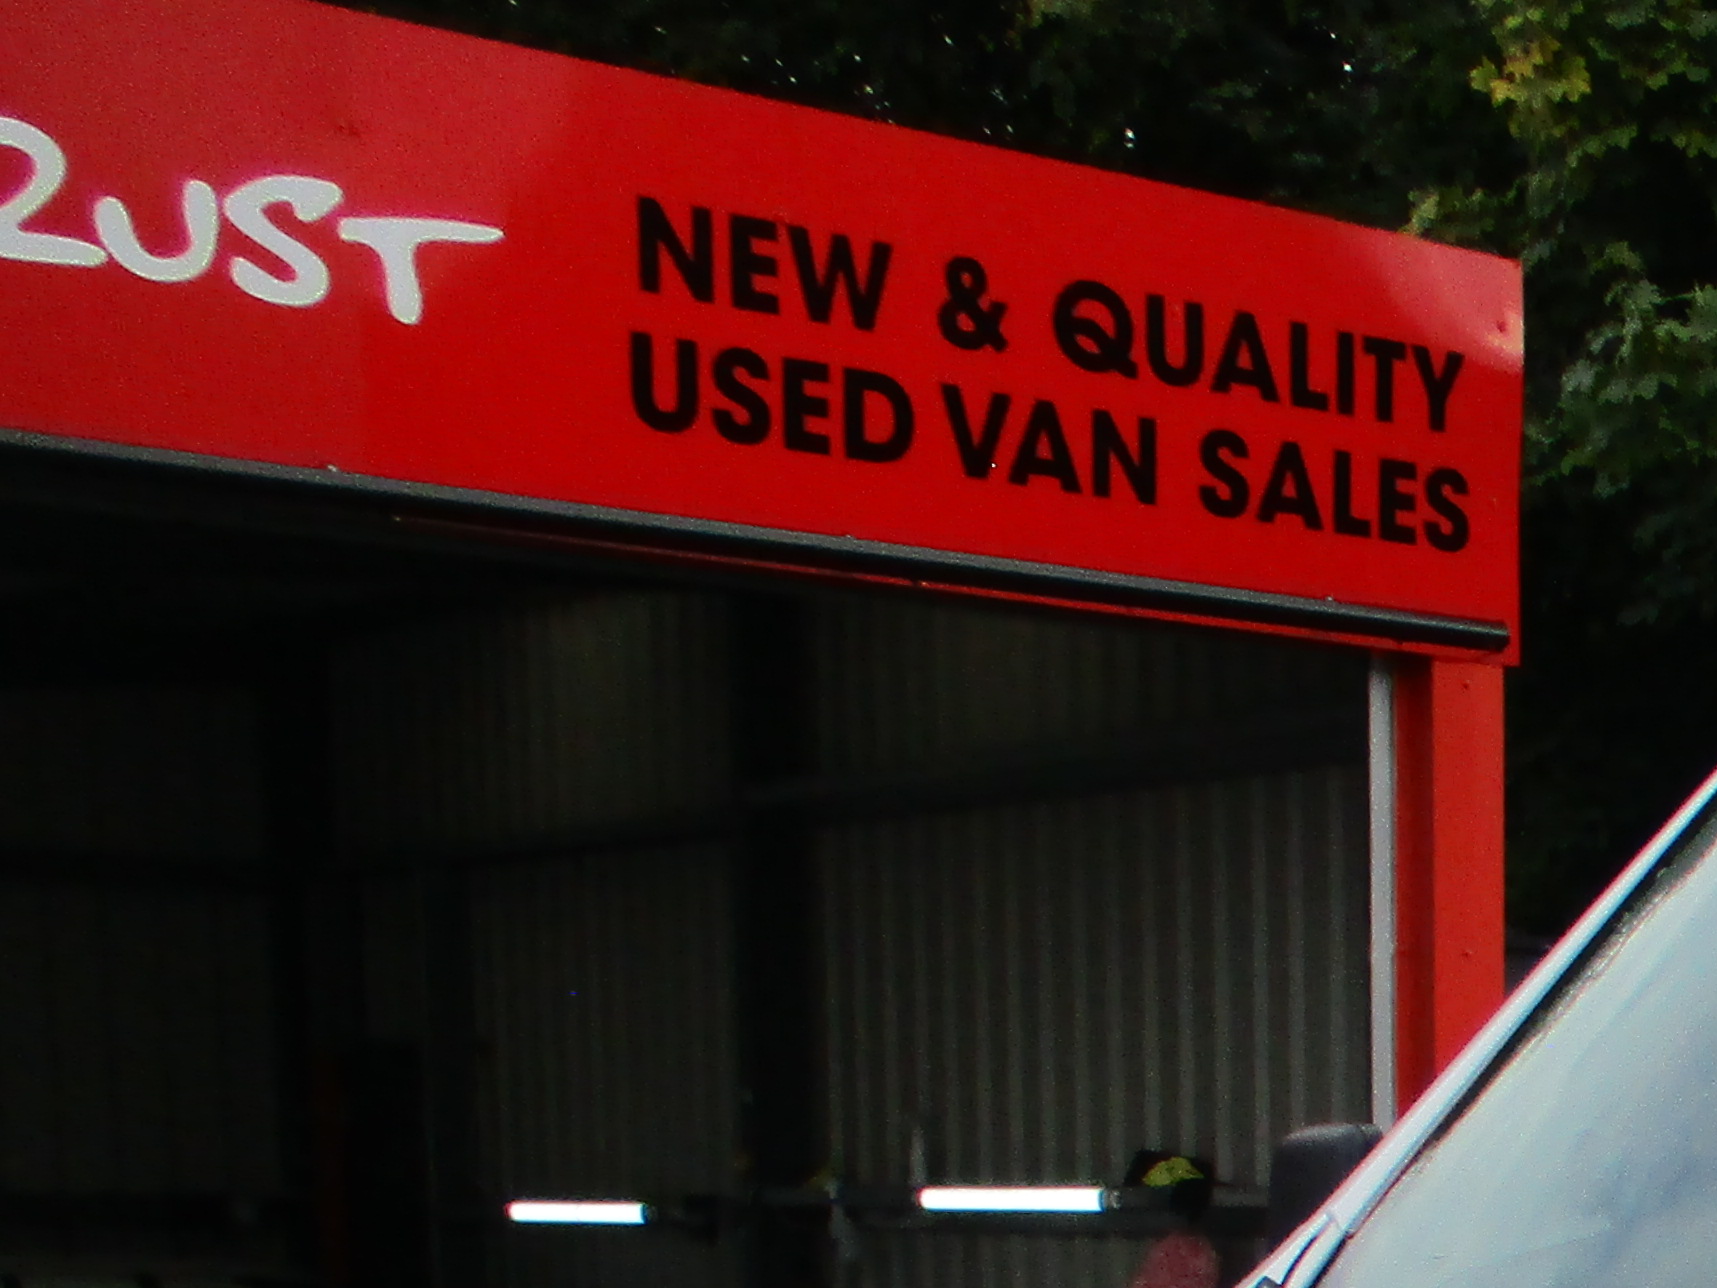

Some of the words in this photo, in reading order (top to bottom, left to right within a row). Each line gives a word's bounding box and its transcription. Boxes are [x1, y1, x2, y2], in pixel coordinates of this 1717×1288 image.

[636, 194, 893, 332] NEW
[937, 256, 1008, 353] &
[1053, 278, 1465, 433] QUALITY
[629, 330, 914, 463] USED
[940, 382, 1156, 506] VAN
[1199, 429, 1470, 553] SALES
